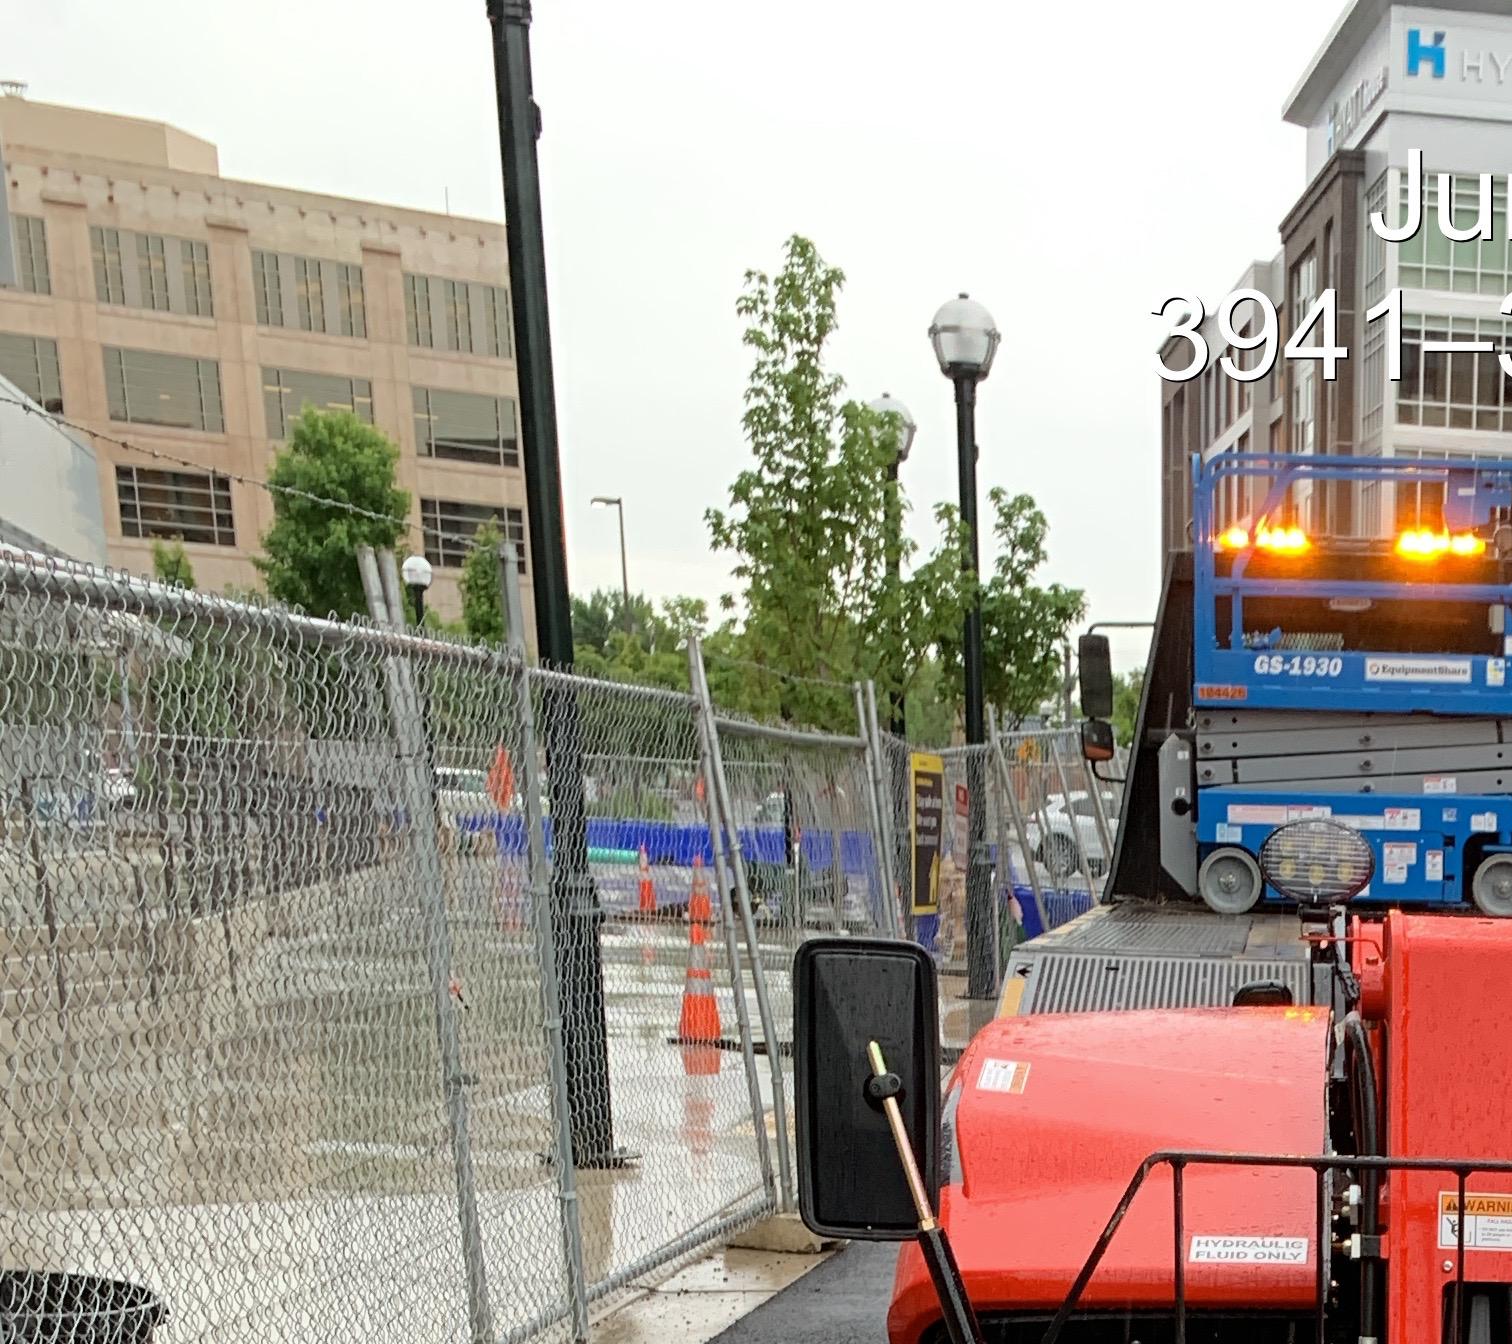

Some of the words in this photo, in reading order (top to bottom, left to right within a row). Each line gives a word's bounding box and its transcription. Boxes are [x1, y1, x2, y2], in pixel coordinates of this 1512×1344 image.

[1253, 654, 1343, 677] GS-1930
[1381, 662, 1468, 676] EquipmentShare
[1196, 1239, 1303, 1249] HYDRAULIC
[1195, 1250, 1248, 1259] FLUID
[1254, 1251, 1302, 1260] ONLY
